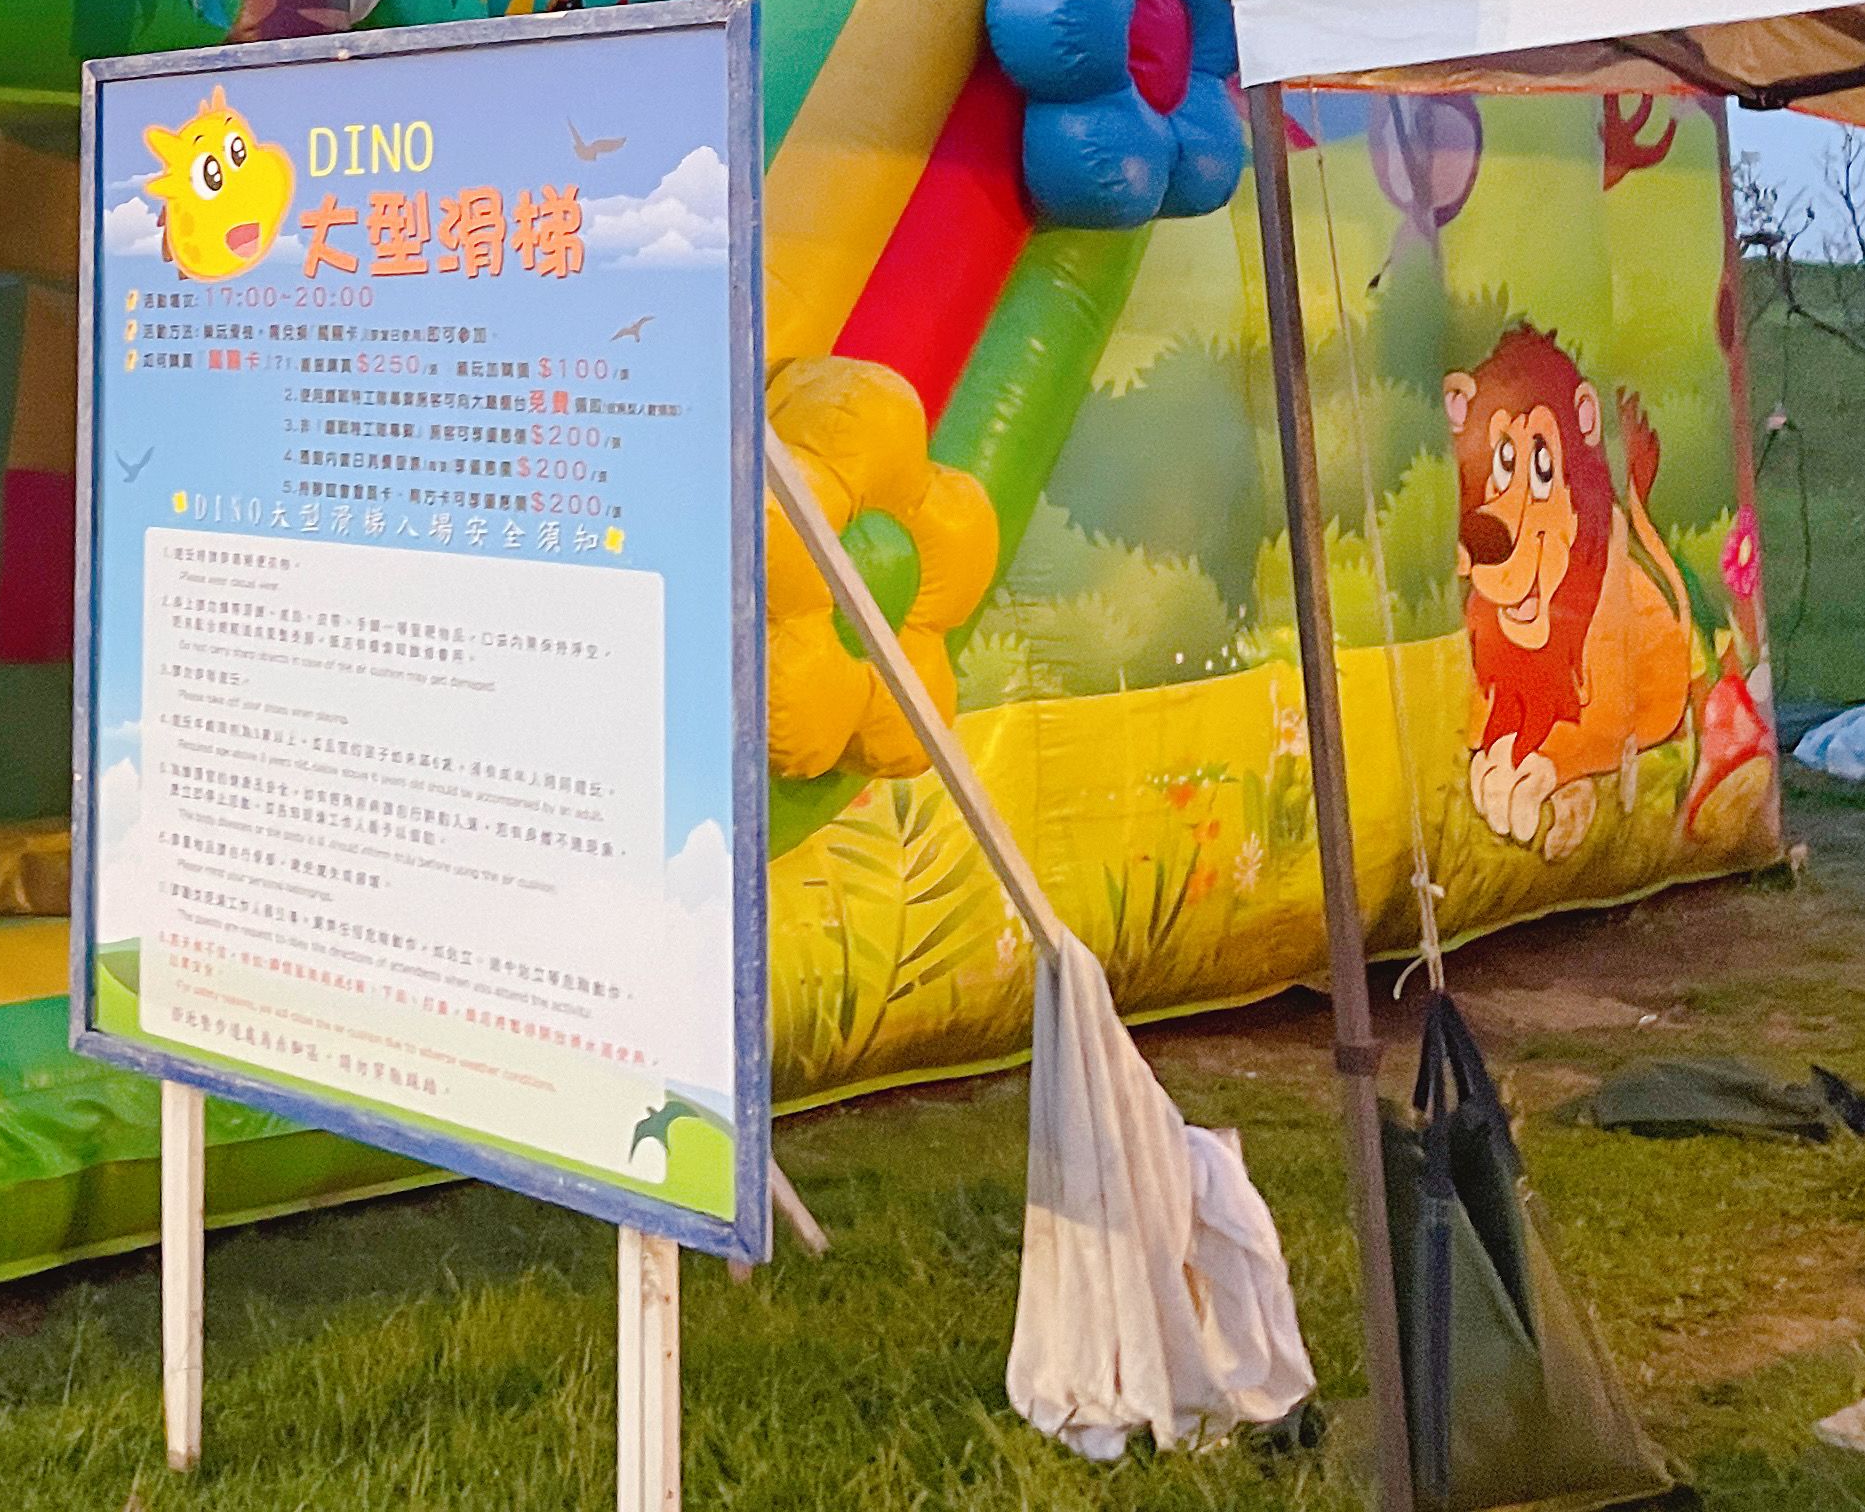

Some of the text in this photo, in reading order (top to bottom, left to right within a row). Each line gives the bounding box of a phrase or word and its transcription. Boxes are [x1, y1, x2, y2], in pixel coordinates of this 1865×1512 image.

[309, 121, 434, 179] DINO
[299, 185, 586, 279] 大型滑梯
